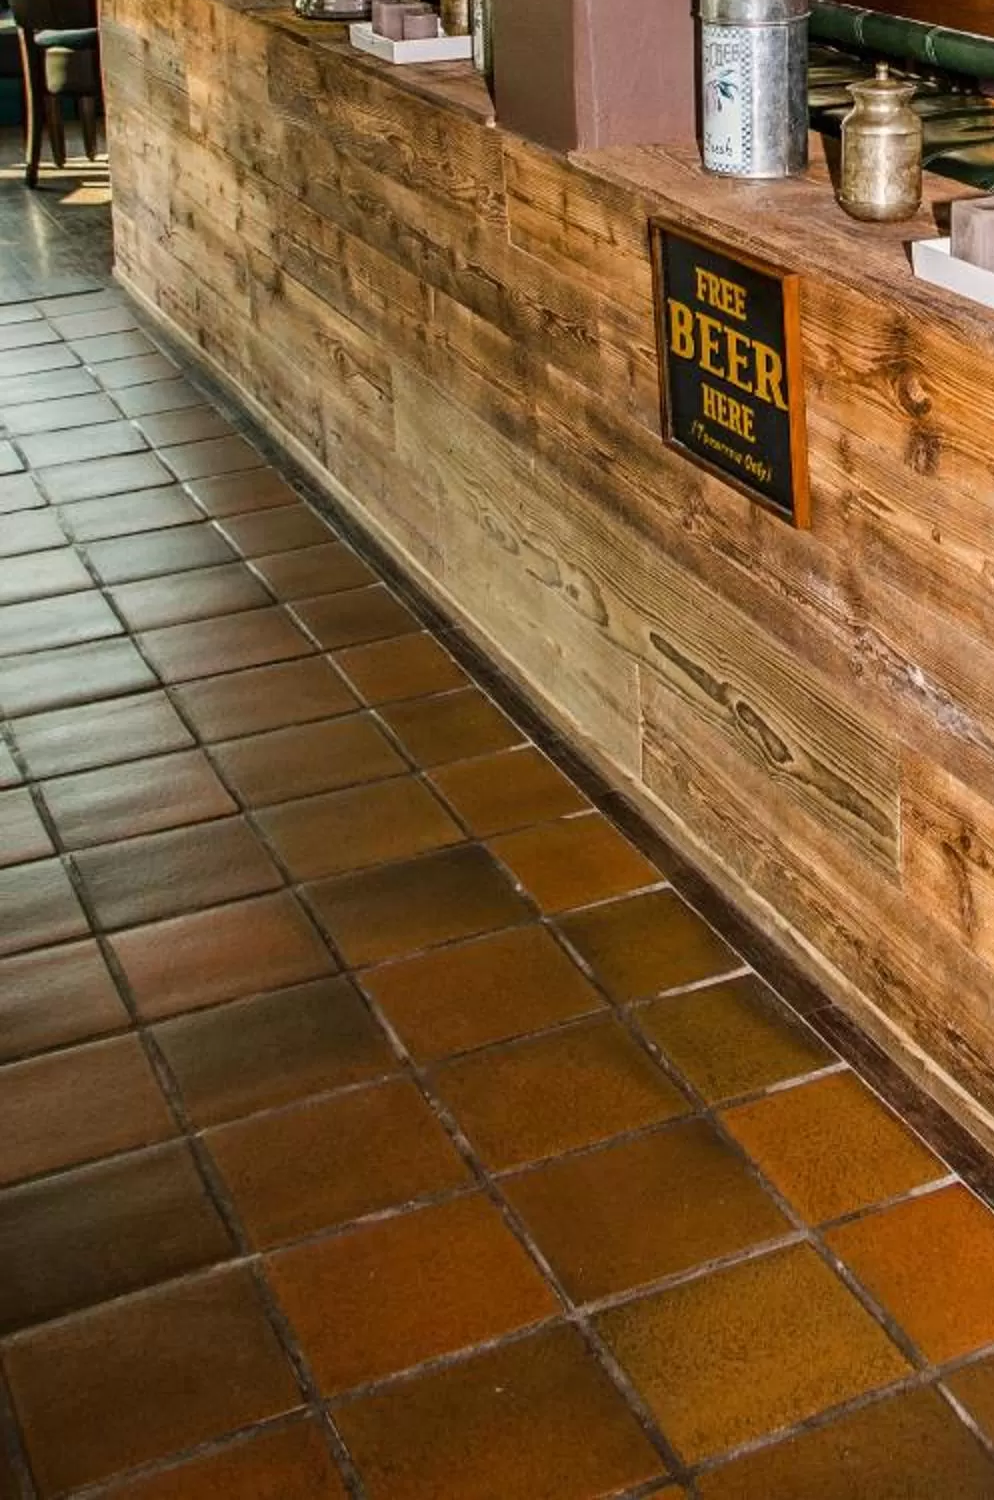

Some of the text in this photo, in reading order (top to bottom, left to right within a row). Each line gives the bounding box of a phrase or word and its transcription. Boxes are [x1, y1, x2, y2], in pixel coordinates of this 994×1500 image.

[695, 266, 747, 321] FREE
[668, 298, 788, 410] BEER
[701, 382, 756, 443] HERE
